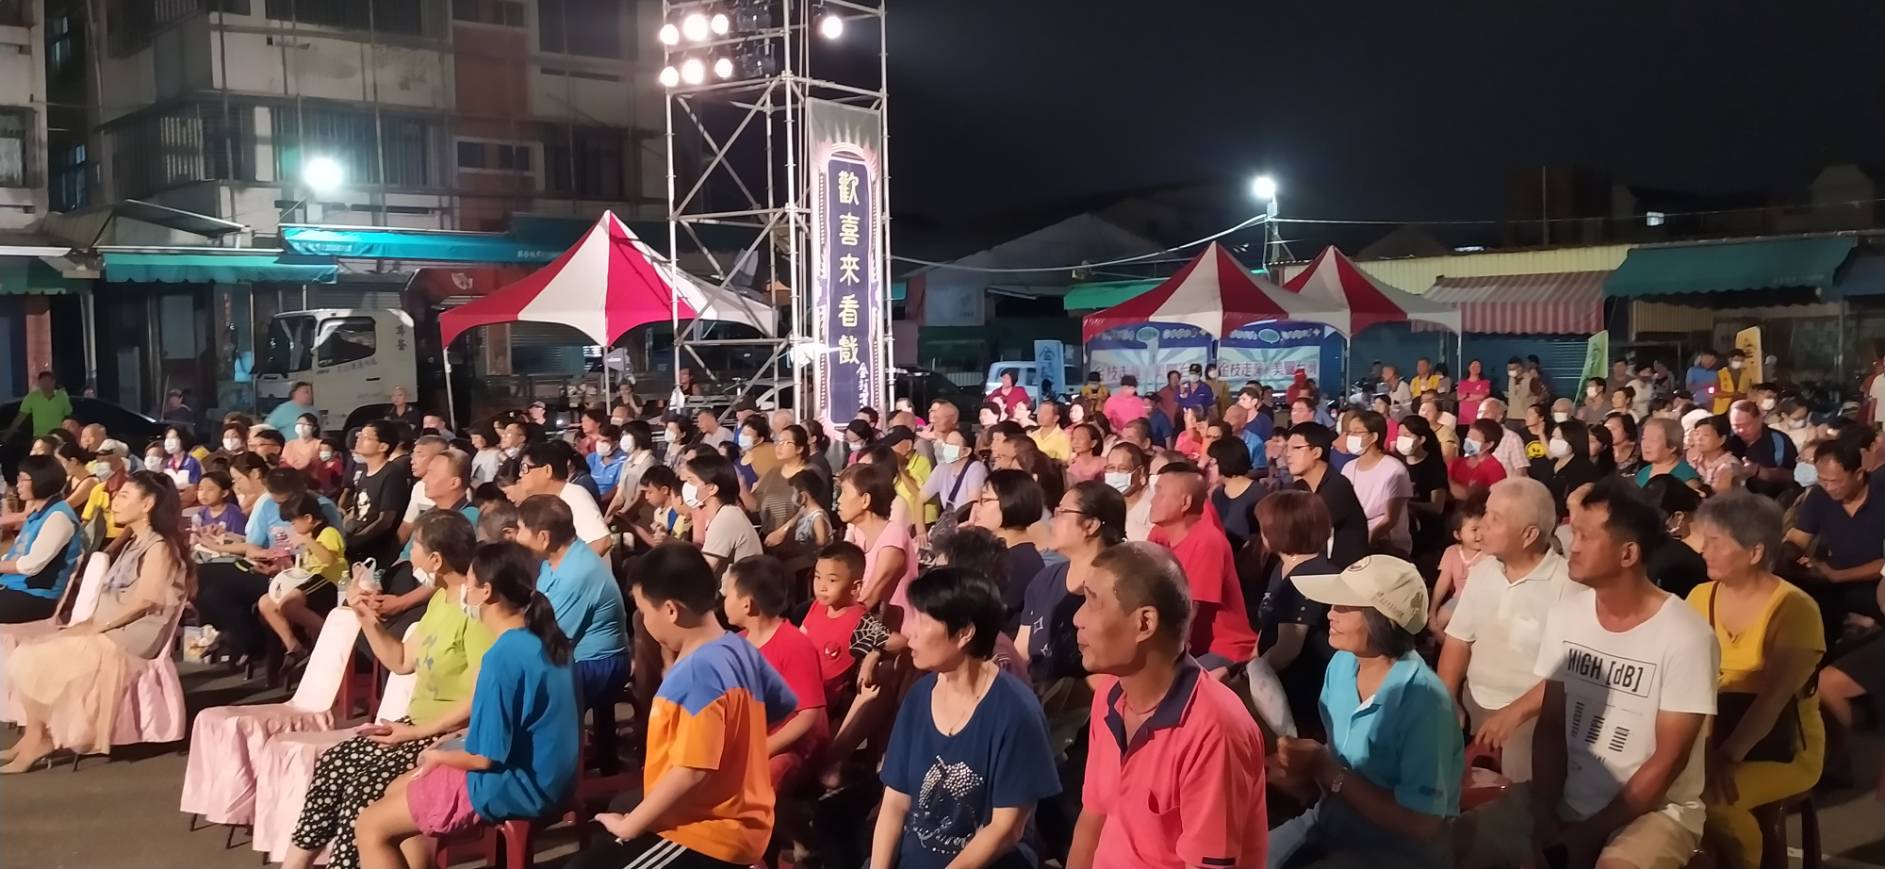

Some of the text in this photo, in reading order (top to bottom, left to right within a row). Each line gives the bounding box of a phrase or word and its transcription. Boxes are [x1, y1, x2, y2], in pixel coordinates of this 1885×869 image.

[838, 170, 860, 365] 歡喜來看戲
[1567, 648, 1644, 693] HIGH [dB]
